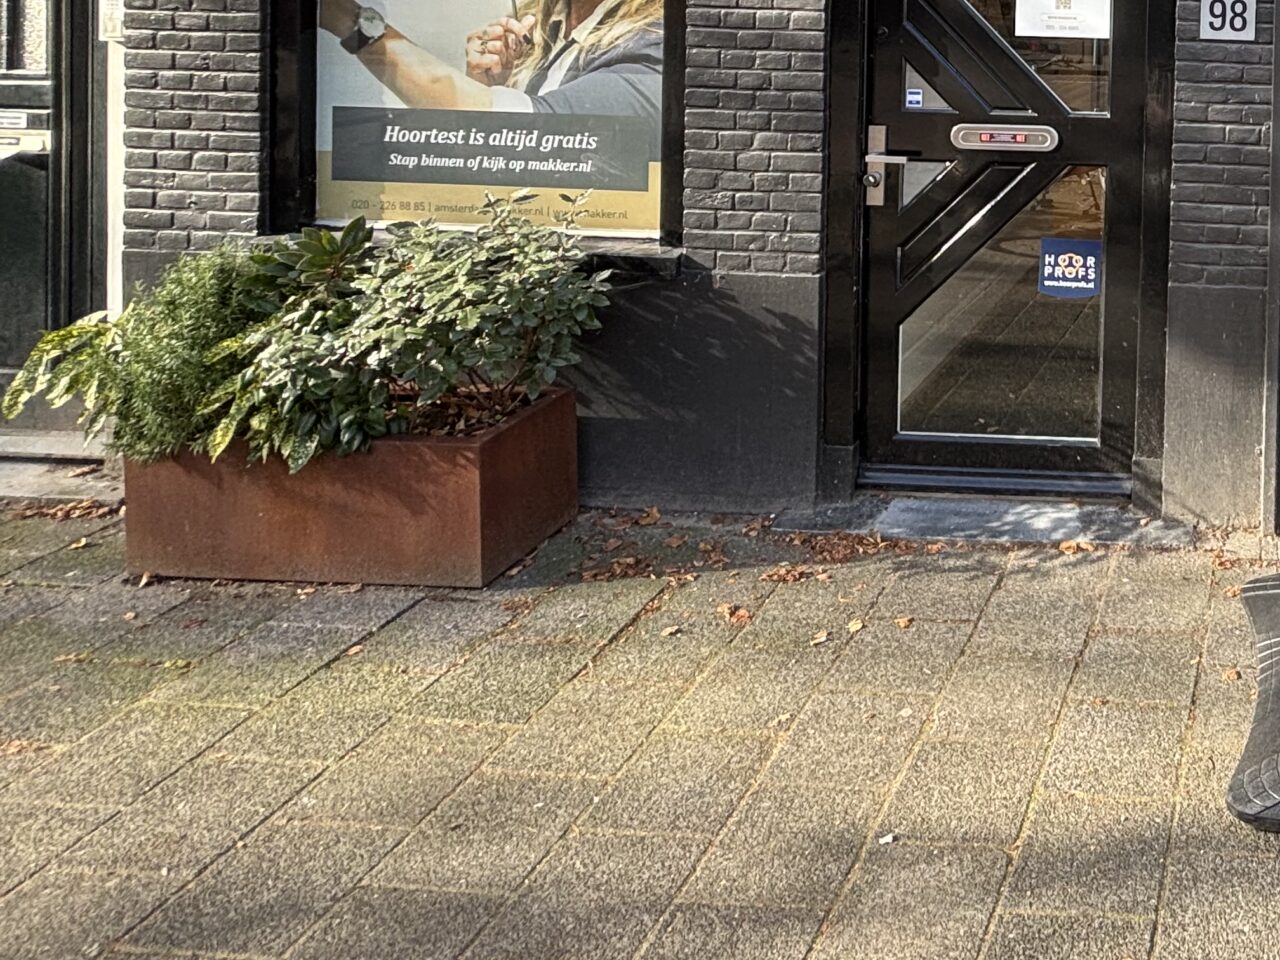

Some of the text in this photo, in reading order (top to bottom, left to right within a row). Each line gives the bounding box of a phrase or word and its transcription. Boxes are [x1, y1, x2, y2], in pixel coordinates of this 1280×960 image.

[384, 125, 598, 152] Hoortest is altijd gratis
[388, 153, 593, 173] Stap binnen of kijk op makker.nl
[351, 200, 370, 210] 020
[1044, 252, 1096, 268] HOOR
[1043, 265, 1097, 280] PROFS
